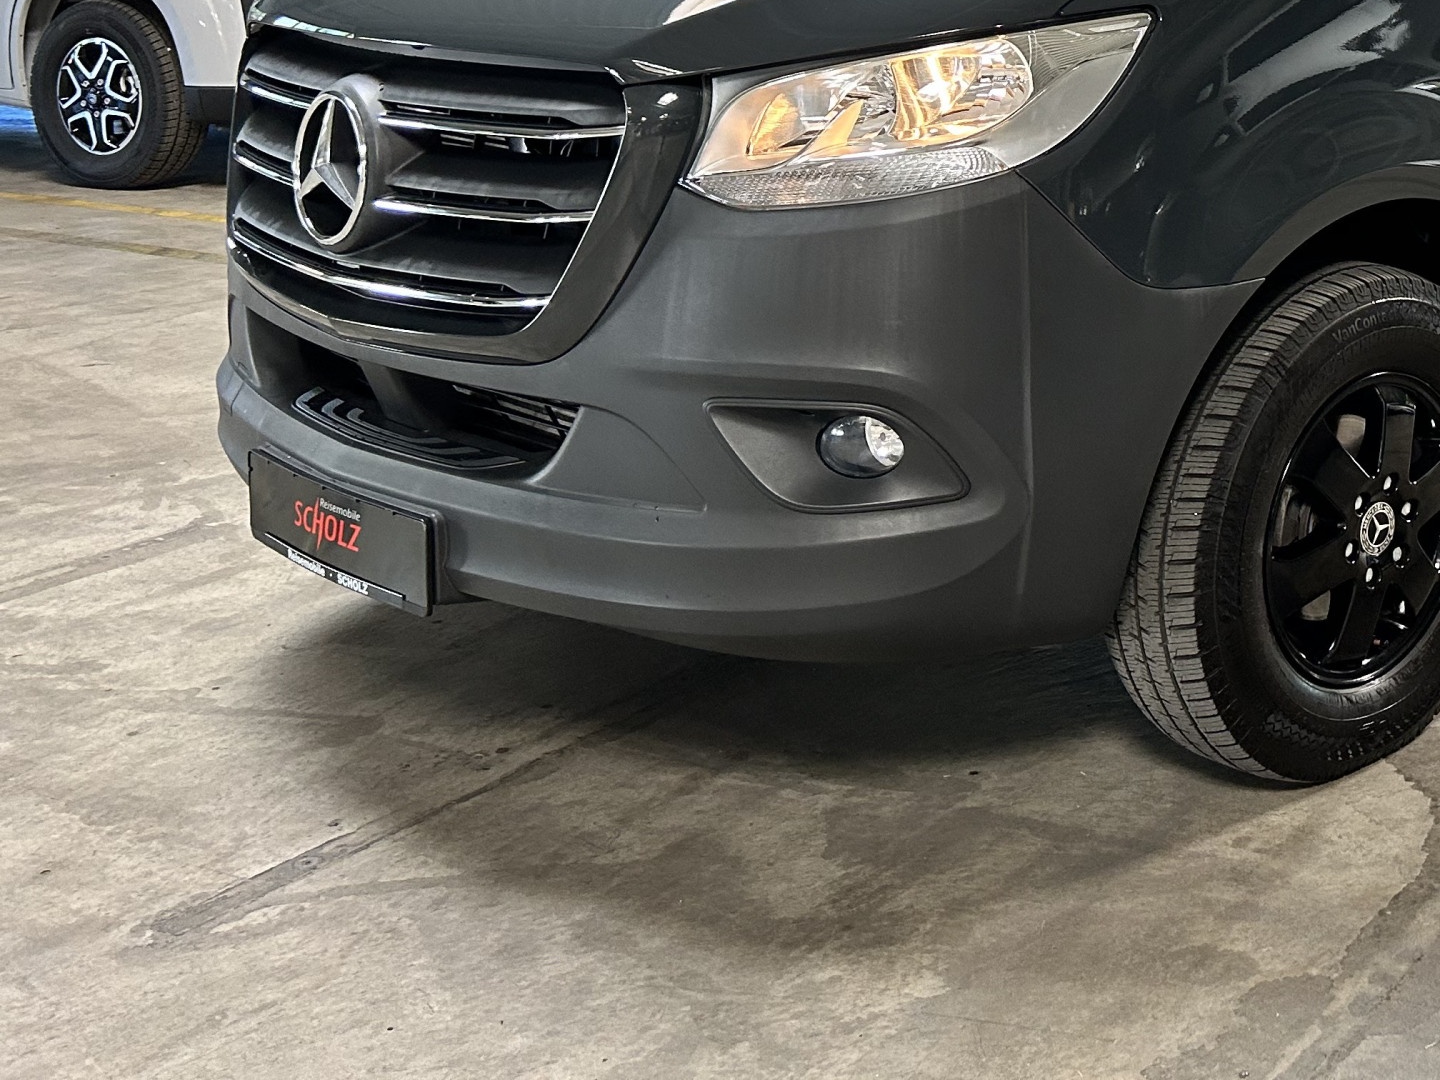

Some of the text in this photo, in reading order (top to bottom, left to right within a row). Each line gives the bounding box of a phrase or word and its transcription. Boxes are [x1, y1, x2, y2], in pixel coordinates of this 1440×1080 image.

[319, 497, 361, 522] Reisemobile
[294, 497, 362, 552] SCHOLZ
[336, 571, 369, 595] SCHOLZ
